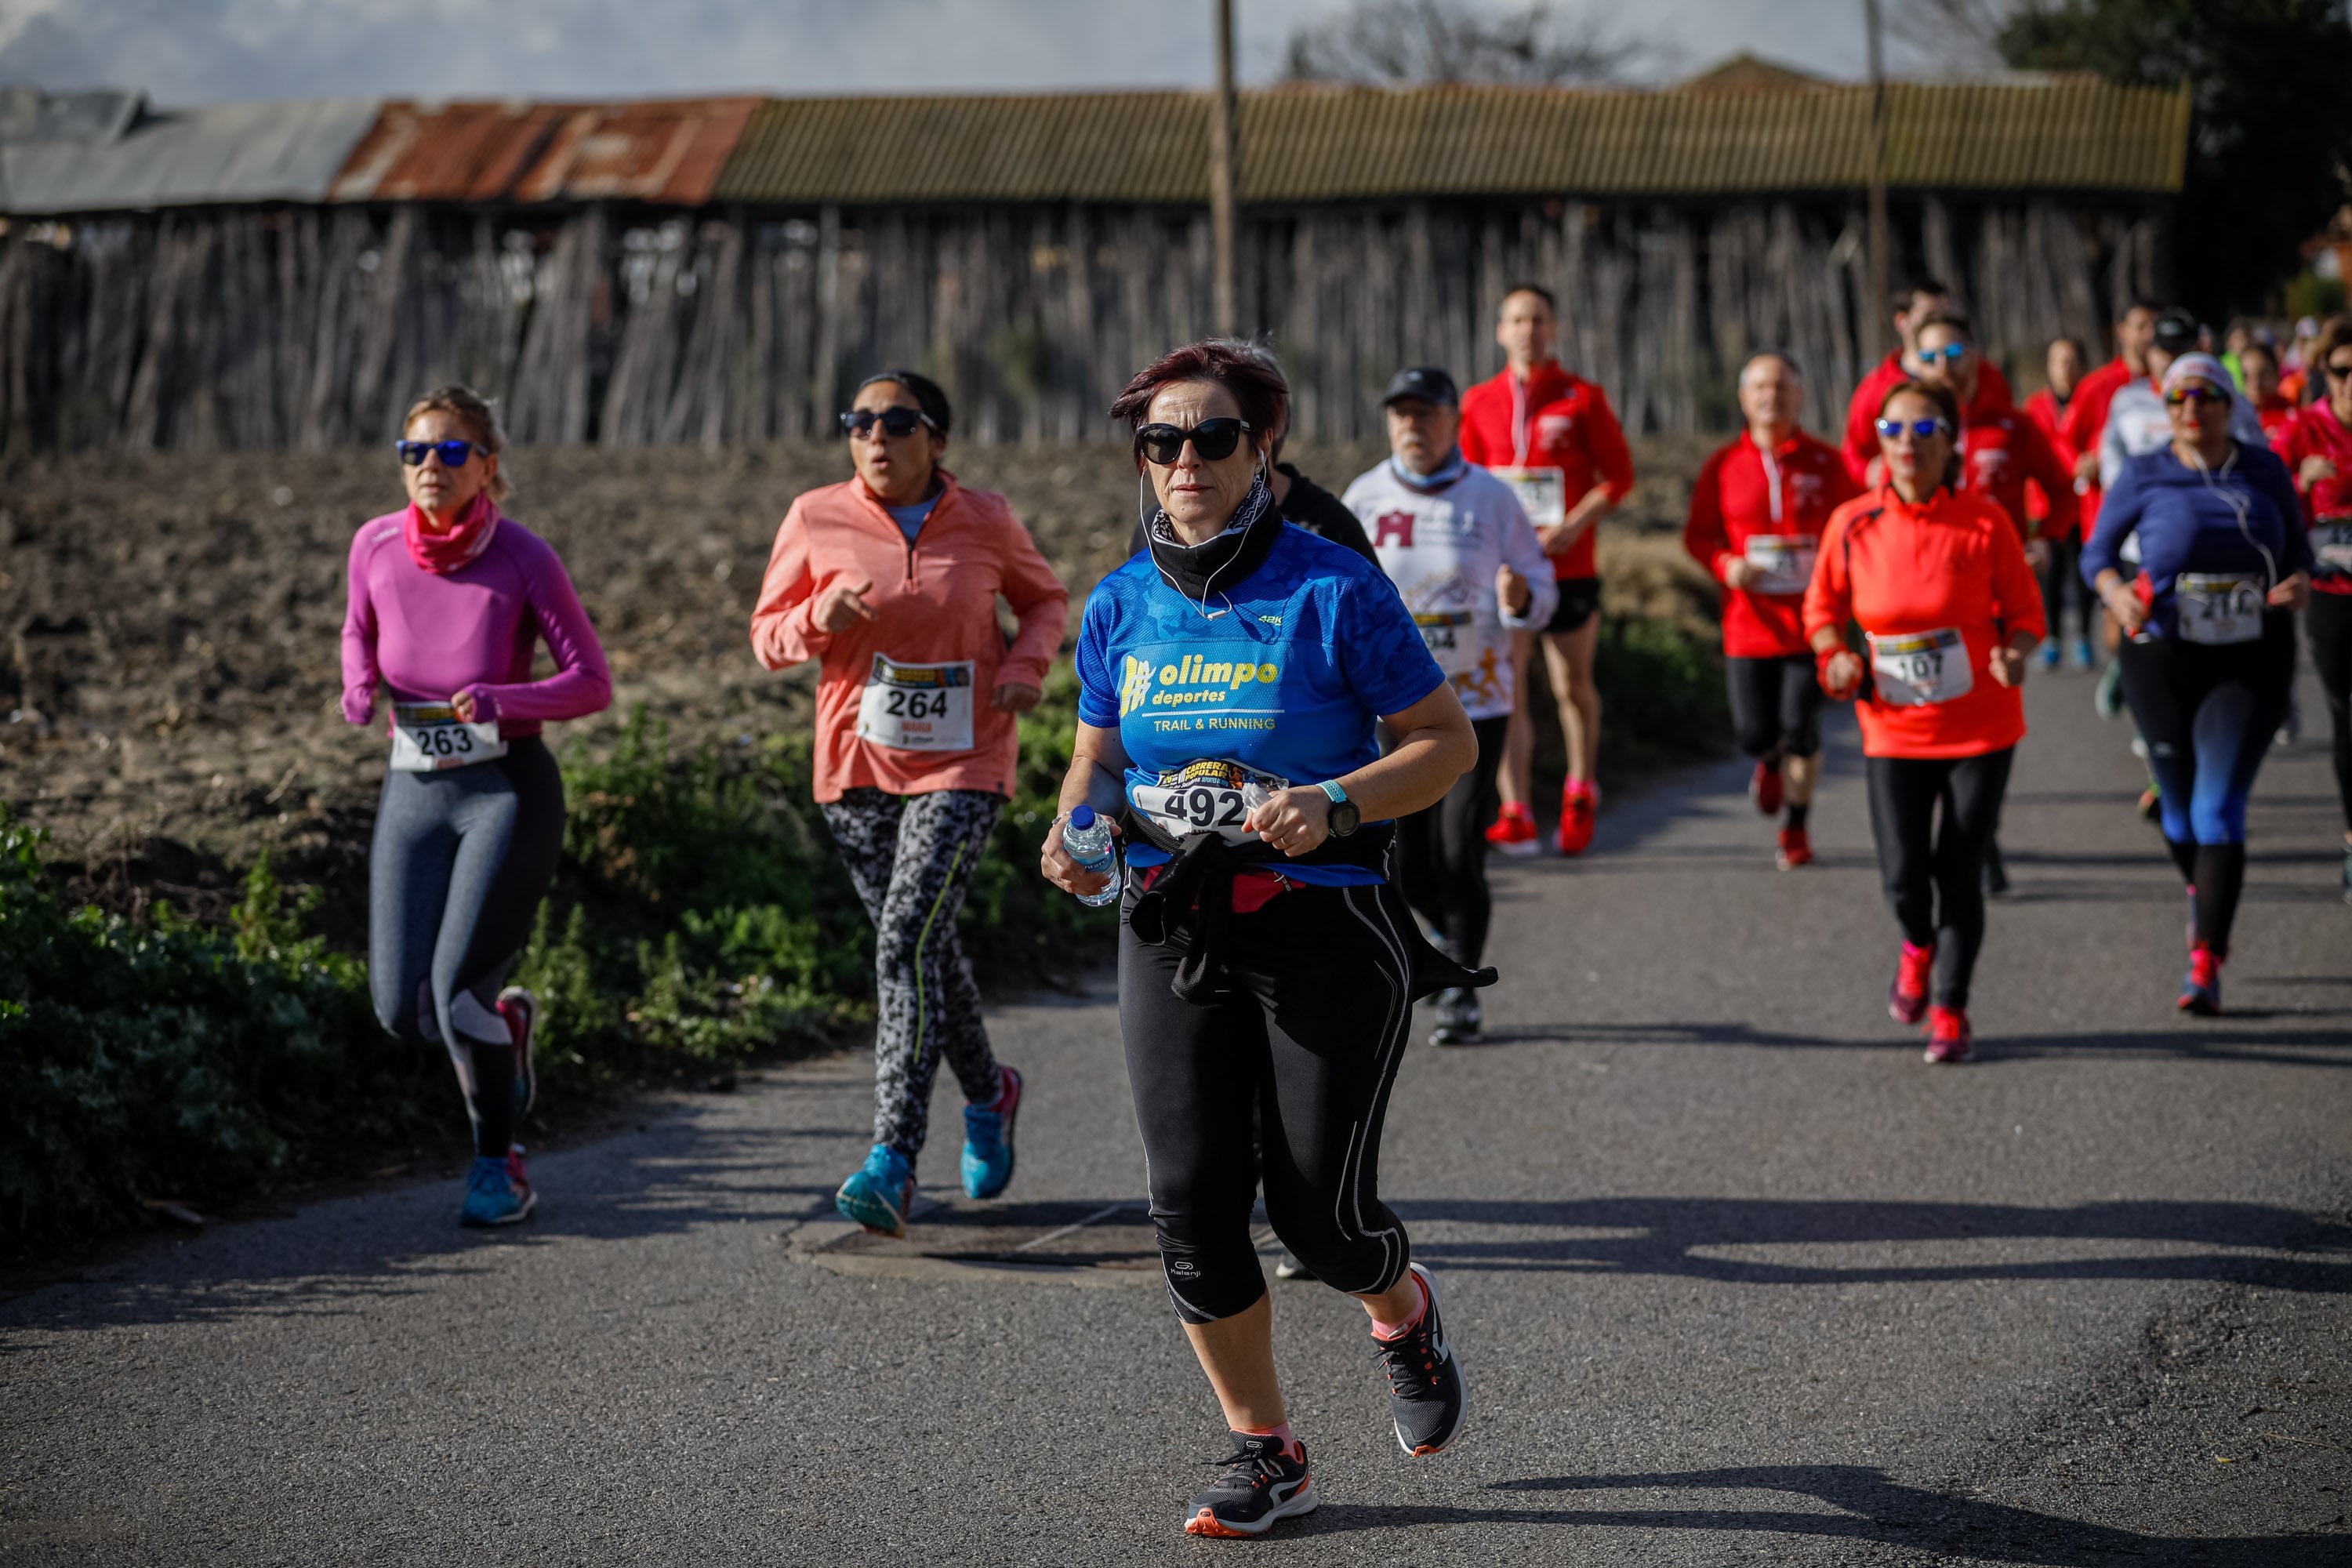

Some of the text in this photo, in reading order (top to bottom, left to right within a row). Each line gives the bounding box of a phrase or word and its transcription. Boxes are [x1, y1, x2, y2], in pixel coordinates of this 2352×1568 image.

[1160, 654, 1278, 690] olimpo
[886, 690, 947, 718] 264
[1152, 690, 1226, 707] deportes
[1153, 717, 1276, 732] TRAIL & RUNNING
[417, 728, 473, 756] 263
[1185, 761, 1229, 775] CARRERA
[1185, 769, 1228, 782] POPULAR
[1164, 788, 1246, 827] 492
